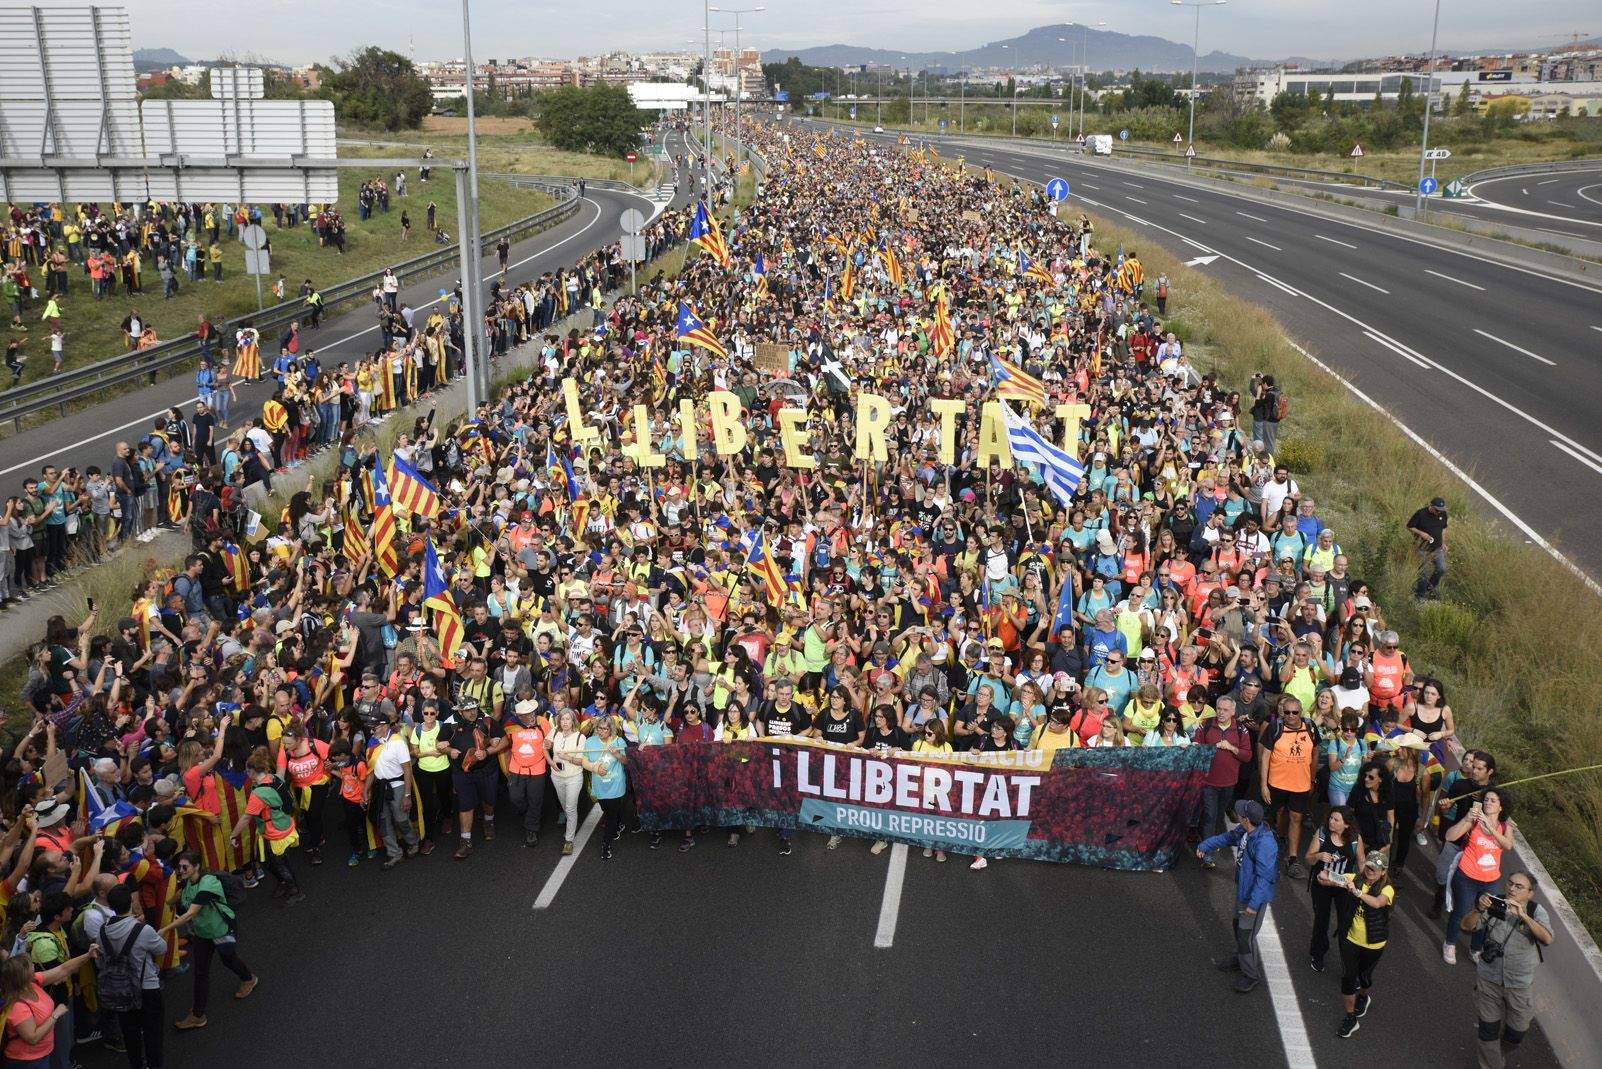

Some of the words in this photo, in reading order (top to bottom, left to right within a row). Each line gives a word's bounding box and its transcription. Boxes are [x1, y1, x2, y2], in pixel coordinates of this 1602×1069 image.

[797, 750, 1041, 818] LLIBERTAT
[836, 807, 884, 832] PROU
[888, 812, 987, 844] REPRESSIÓ
